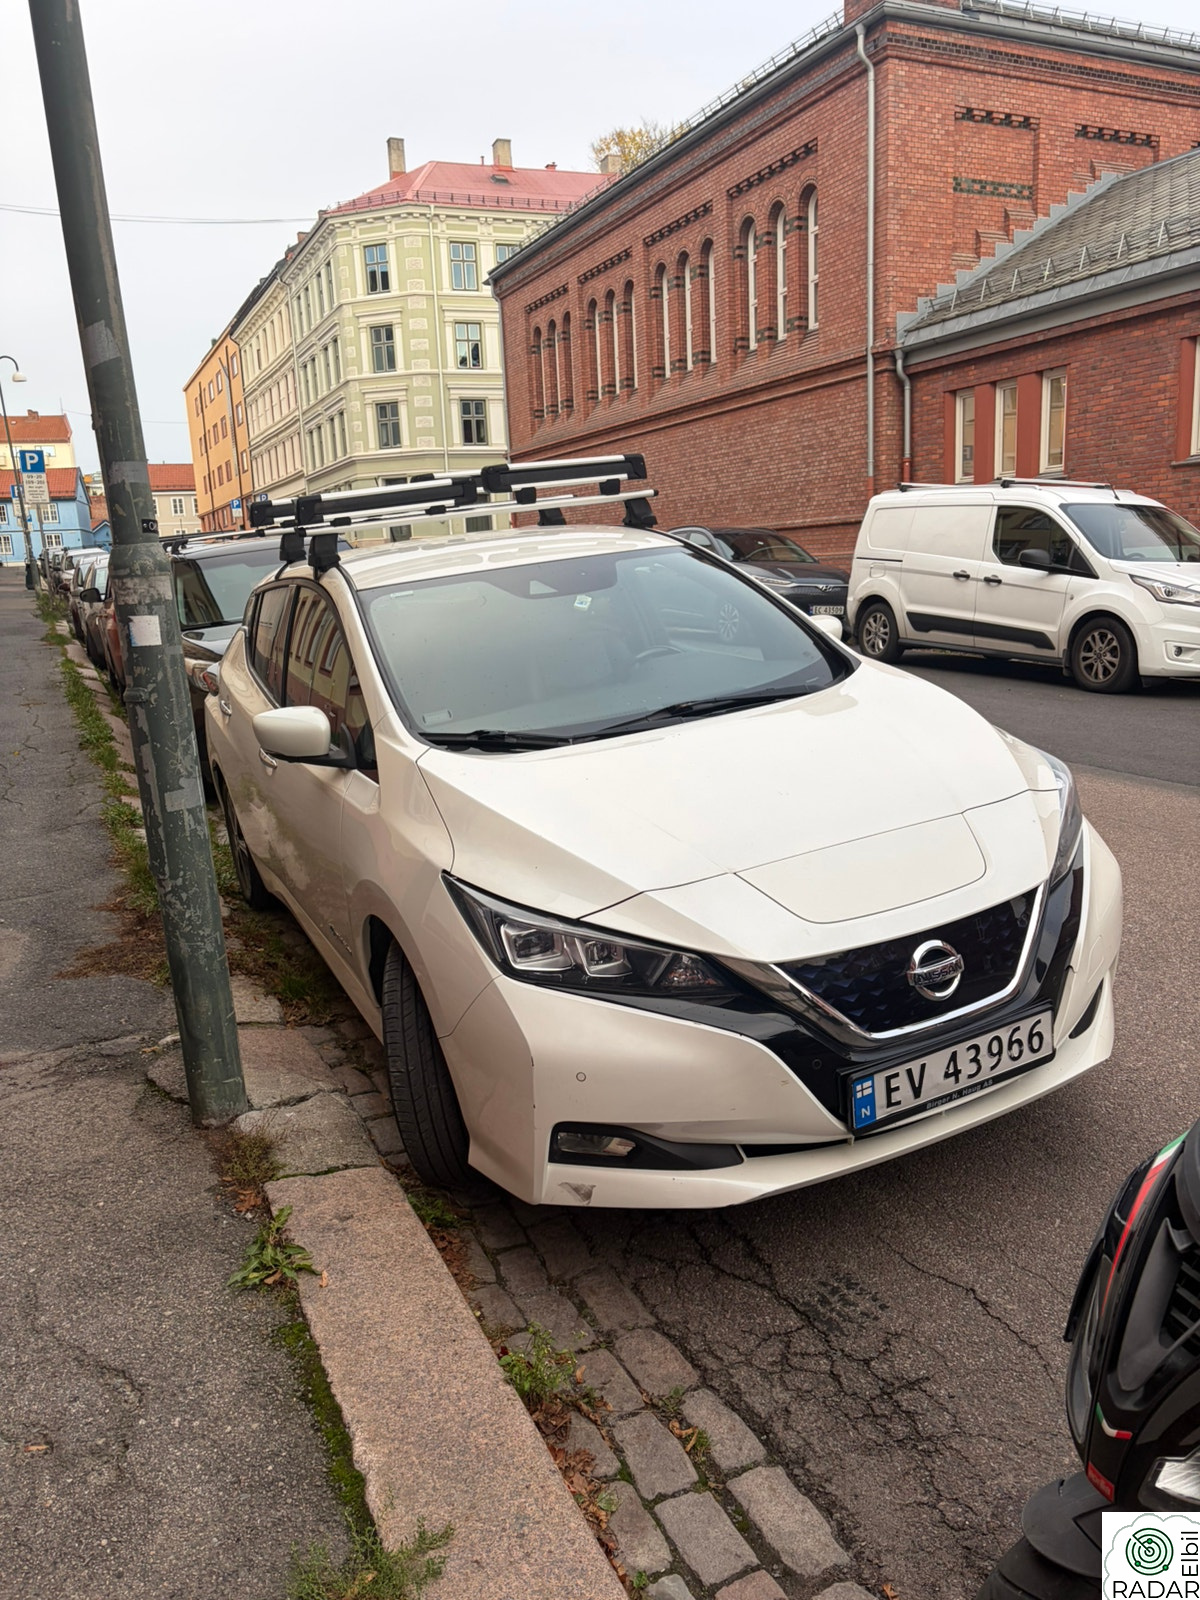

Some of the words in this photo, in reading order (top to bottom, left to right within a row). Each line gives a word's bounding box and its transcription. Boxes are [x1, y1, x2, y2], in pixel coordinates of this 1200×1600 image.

[24, 452, 39, 471] P
[914, 958, 961, 986] NISSAN
[884, 1062, 927, 1109] EV
[943, 1018, 1044, 1085] 43966
[926, 1097, 950, 1109] Birger
[951, 1092, 960, 1100] N.
[962, 1084, 981, 1096] Haug
[861, 1105, 871, 1119] N
